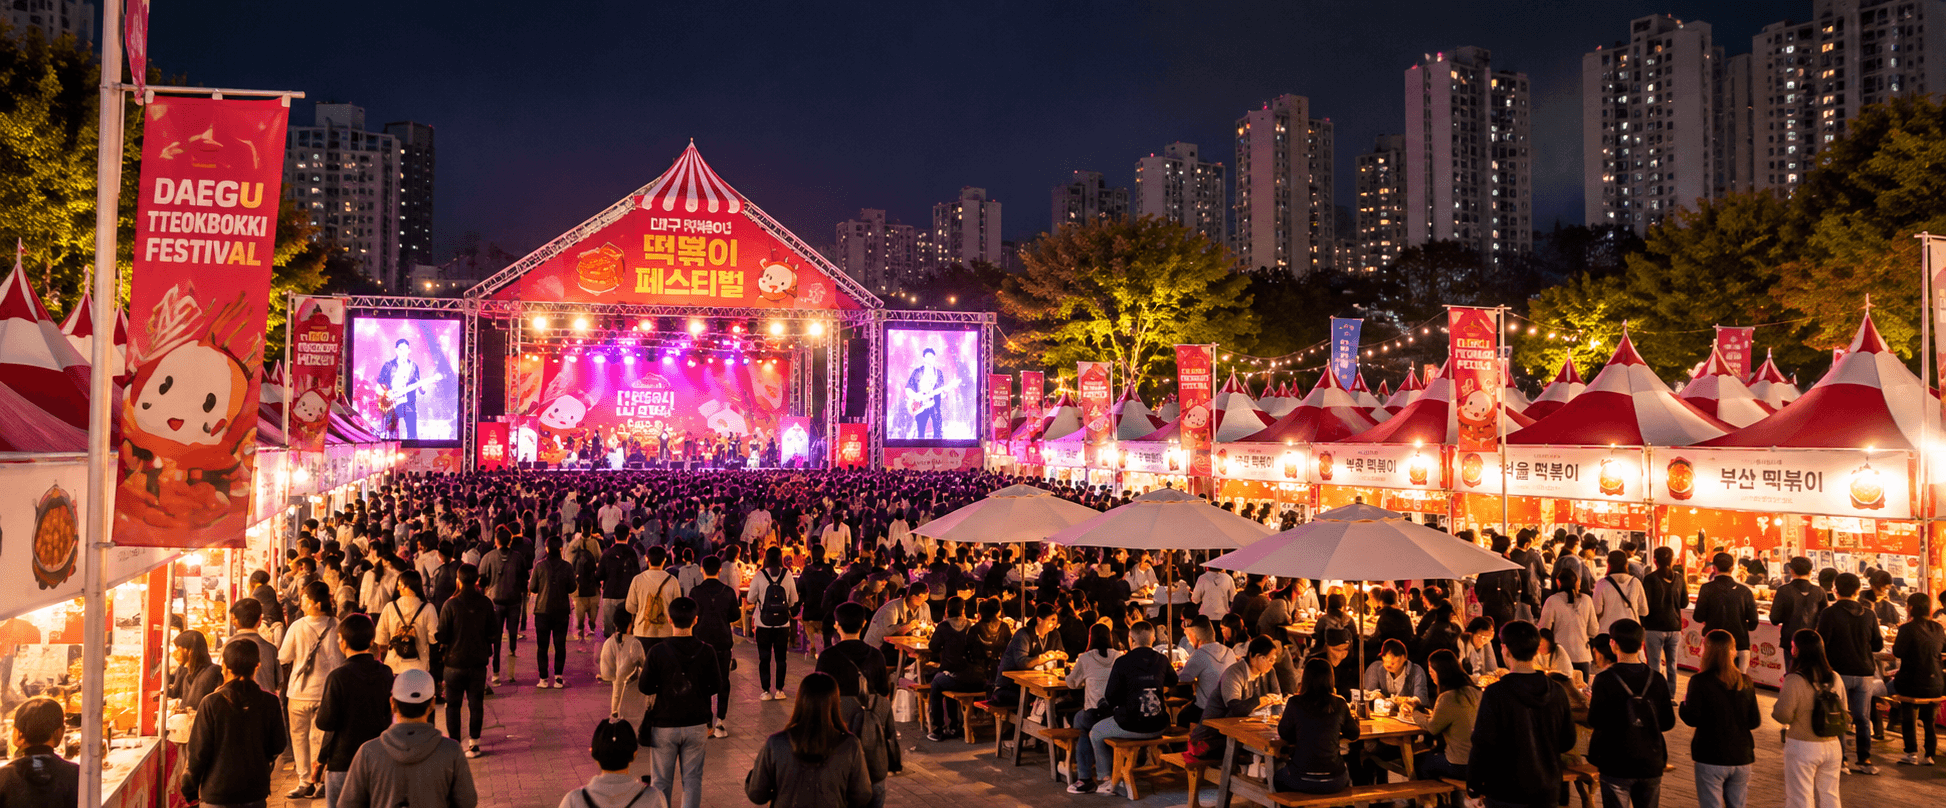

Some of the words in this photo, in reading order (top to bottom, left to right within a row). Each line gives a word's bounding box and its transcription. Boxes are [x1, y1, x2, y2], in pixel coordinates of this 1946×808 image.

[154, 178, 264, 208] DAEGU
[148, 211, 268, 237] TTEOKBOKKI
[145, 238, 262, 266] FESTIVAL
[635, 267, 744, 298] 페스티벌
[1720, 468, 1757, 489] 부산
